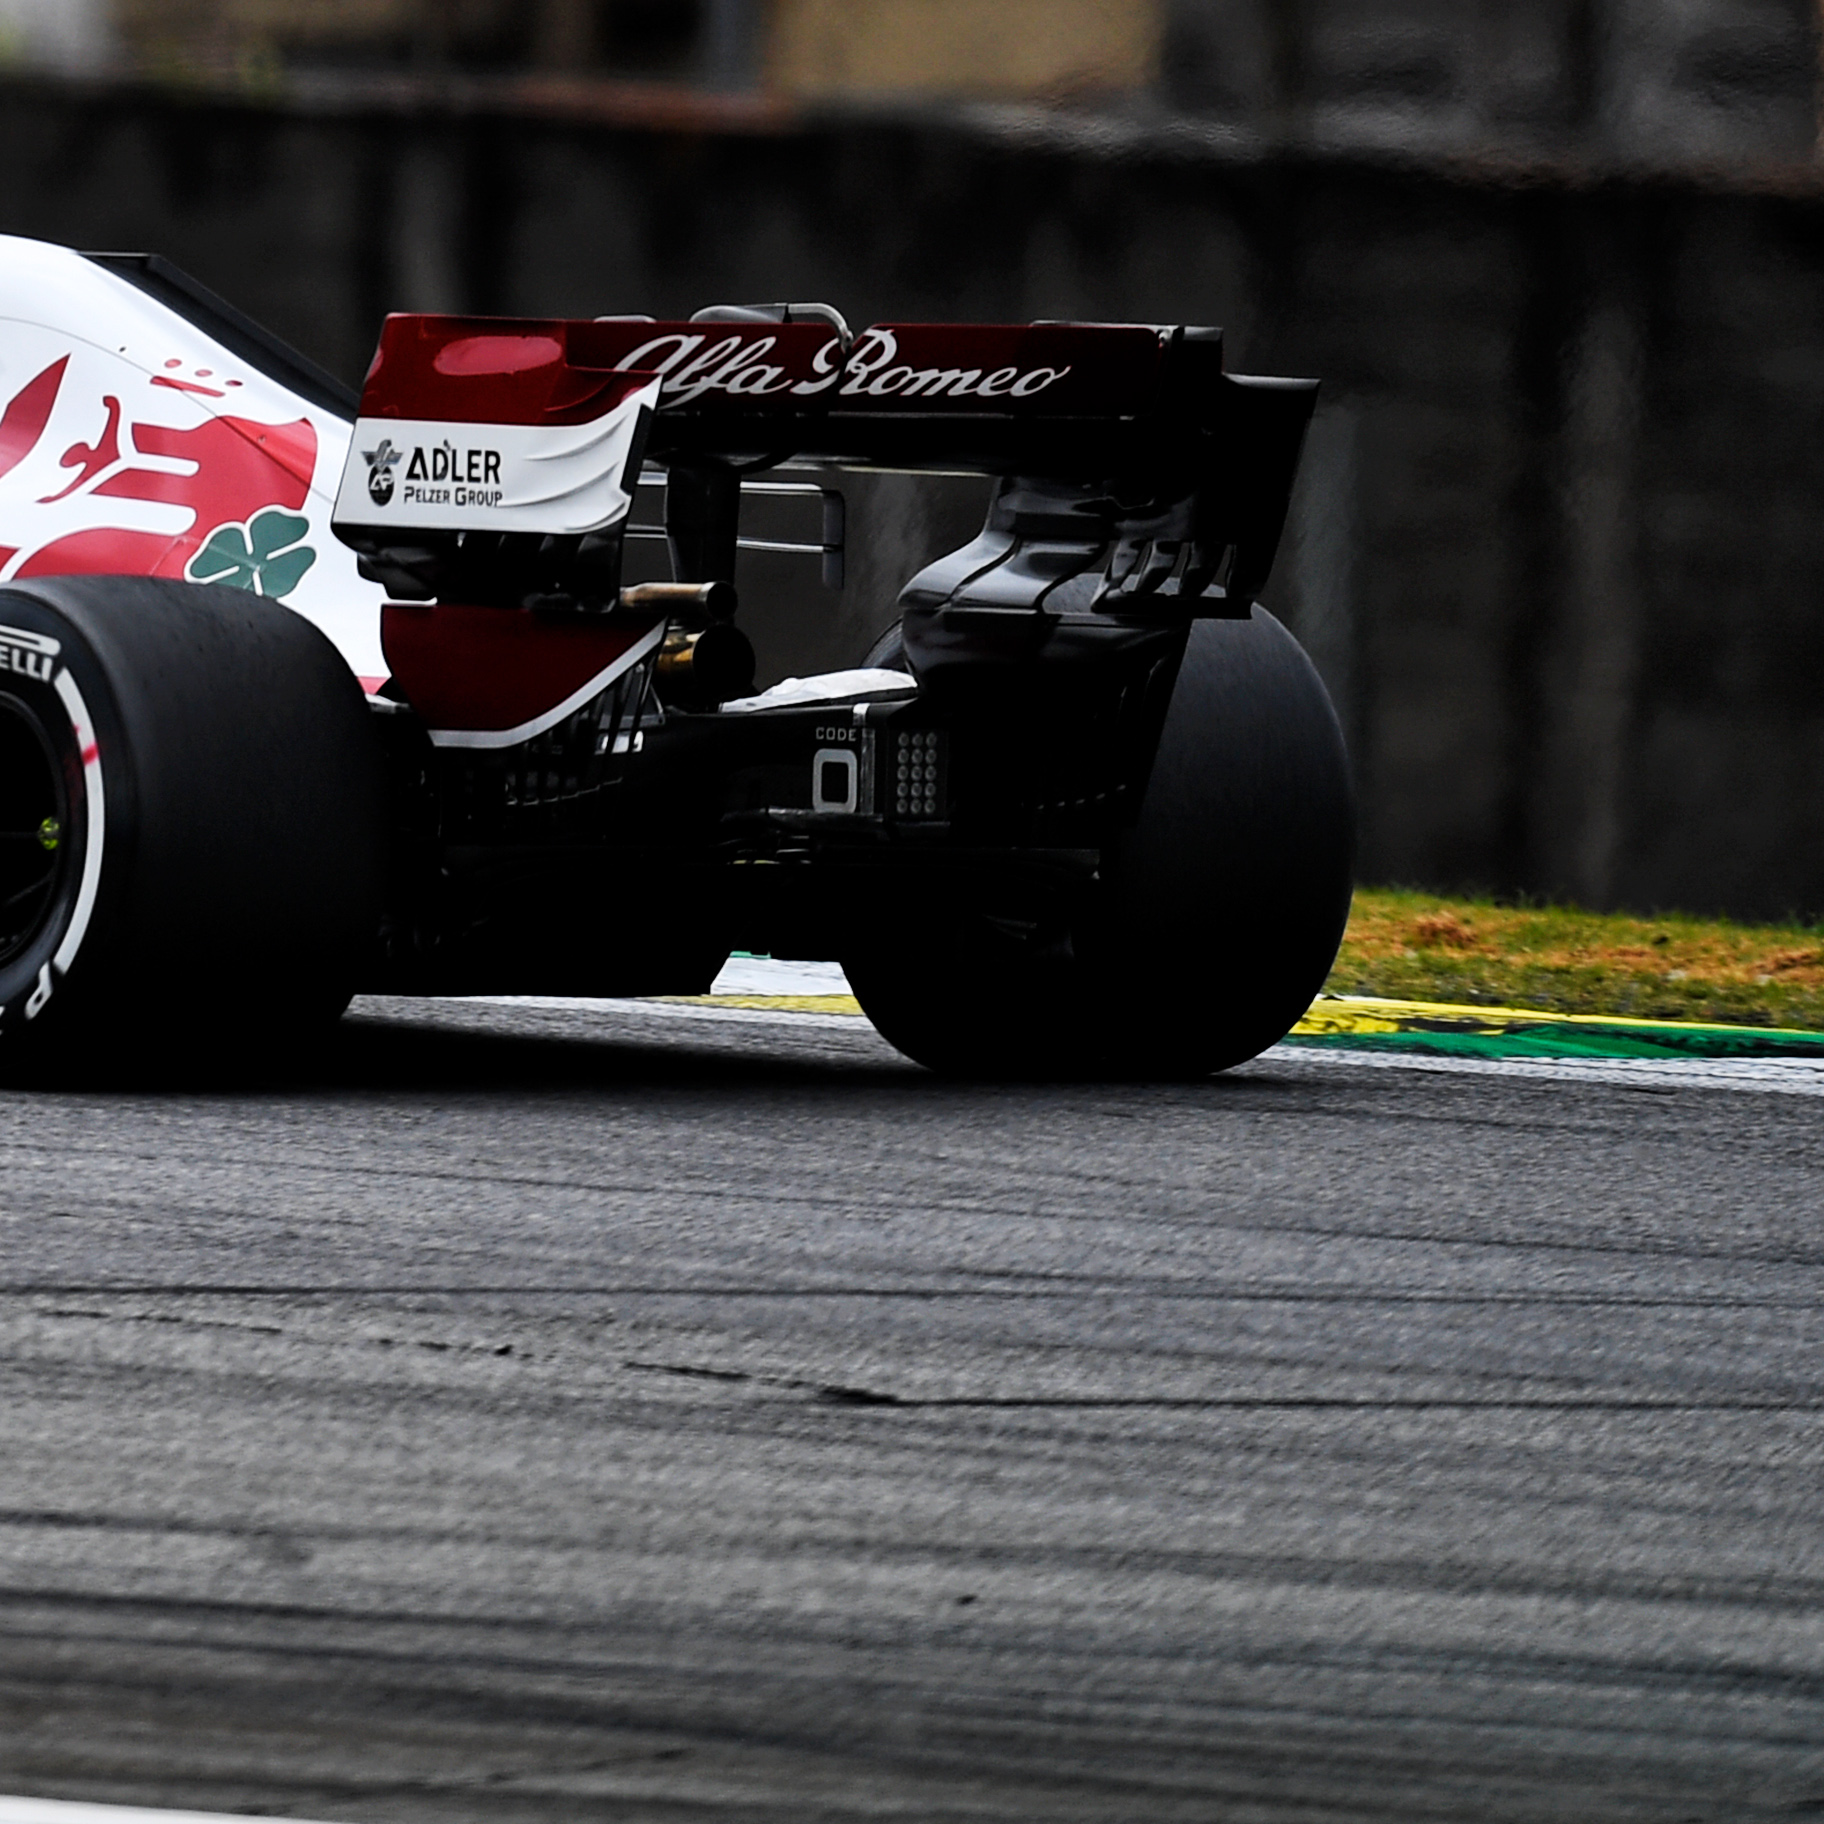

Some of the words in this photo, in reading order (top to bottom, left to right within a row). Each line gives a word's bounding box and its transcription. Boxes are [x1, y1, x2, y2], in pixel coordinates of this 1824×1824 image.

[614, 334, 793, 410] Alfa
[790, 328, 1072, 396] Romeo
[405, 446, 501, 484] ADLER
[815, 727, 857, 741] CODE
[24, 960, 52, 1020] P
